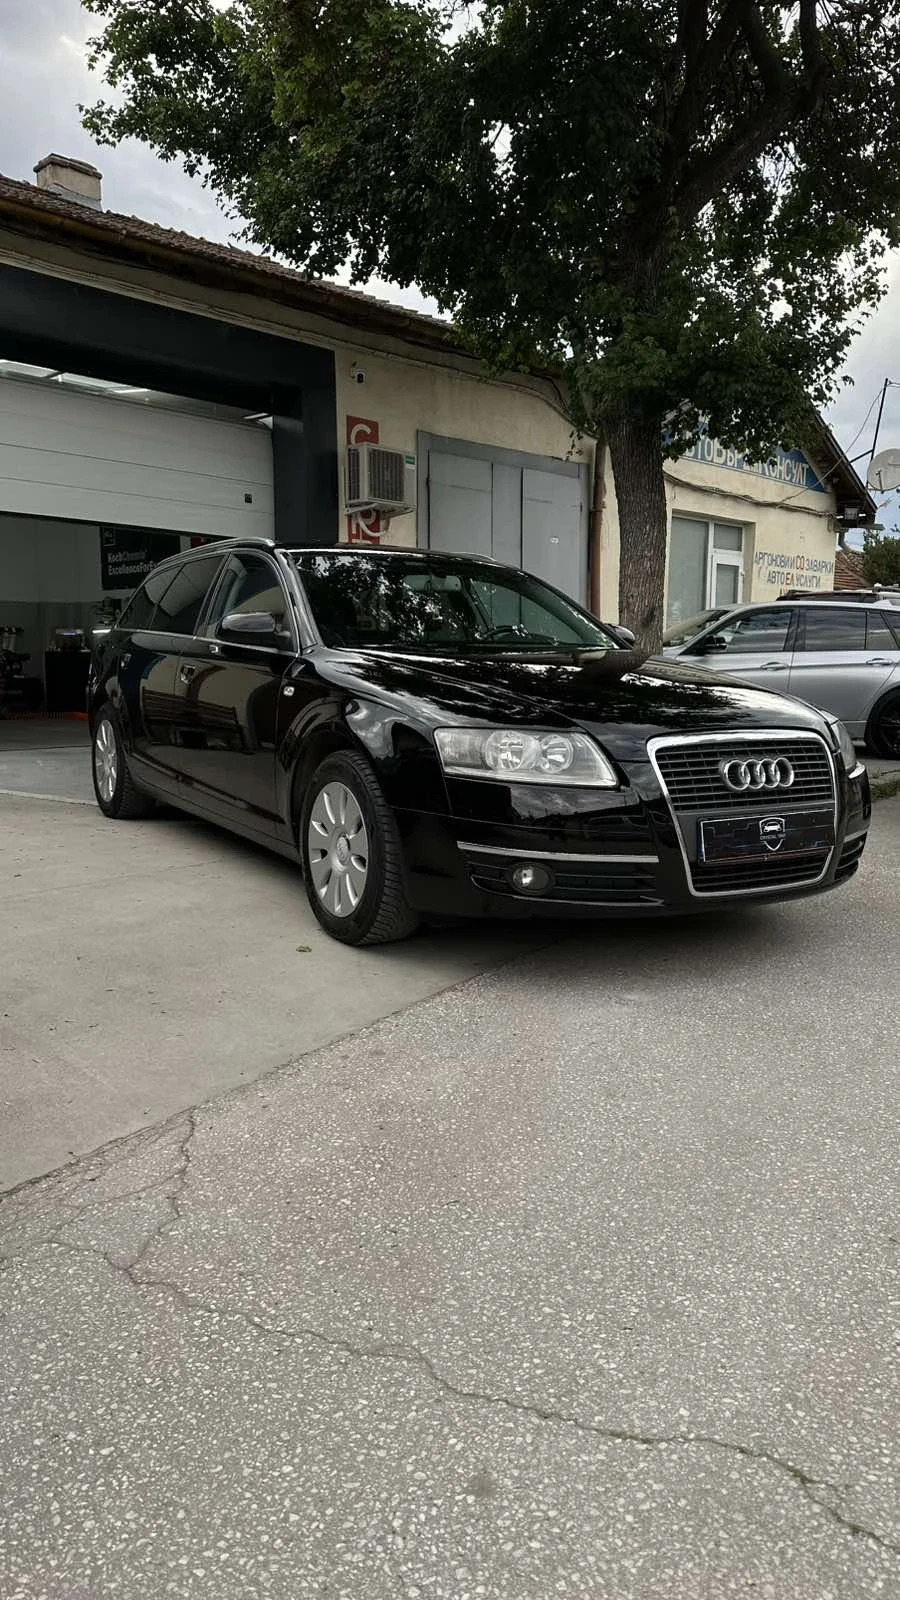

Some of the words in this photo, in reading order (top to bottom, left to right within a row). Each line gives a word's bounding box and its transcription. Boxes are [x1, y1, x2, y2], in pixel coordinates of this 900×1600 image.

[805, 558, 834, 575] ЗАВАРКИ
[767, 570, 785, 585] АВТО
[796, 573, 821, 588] УСЛУГИ
